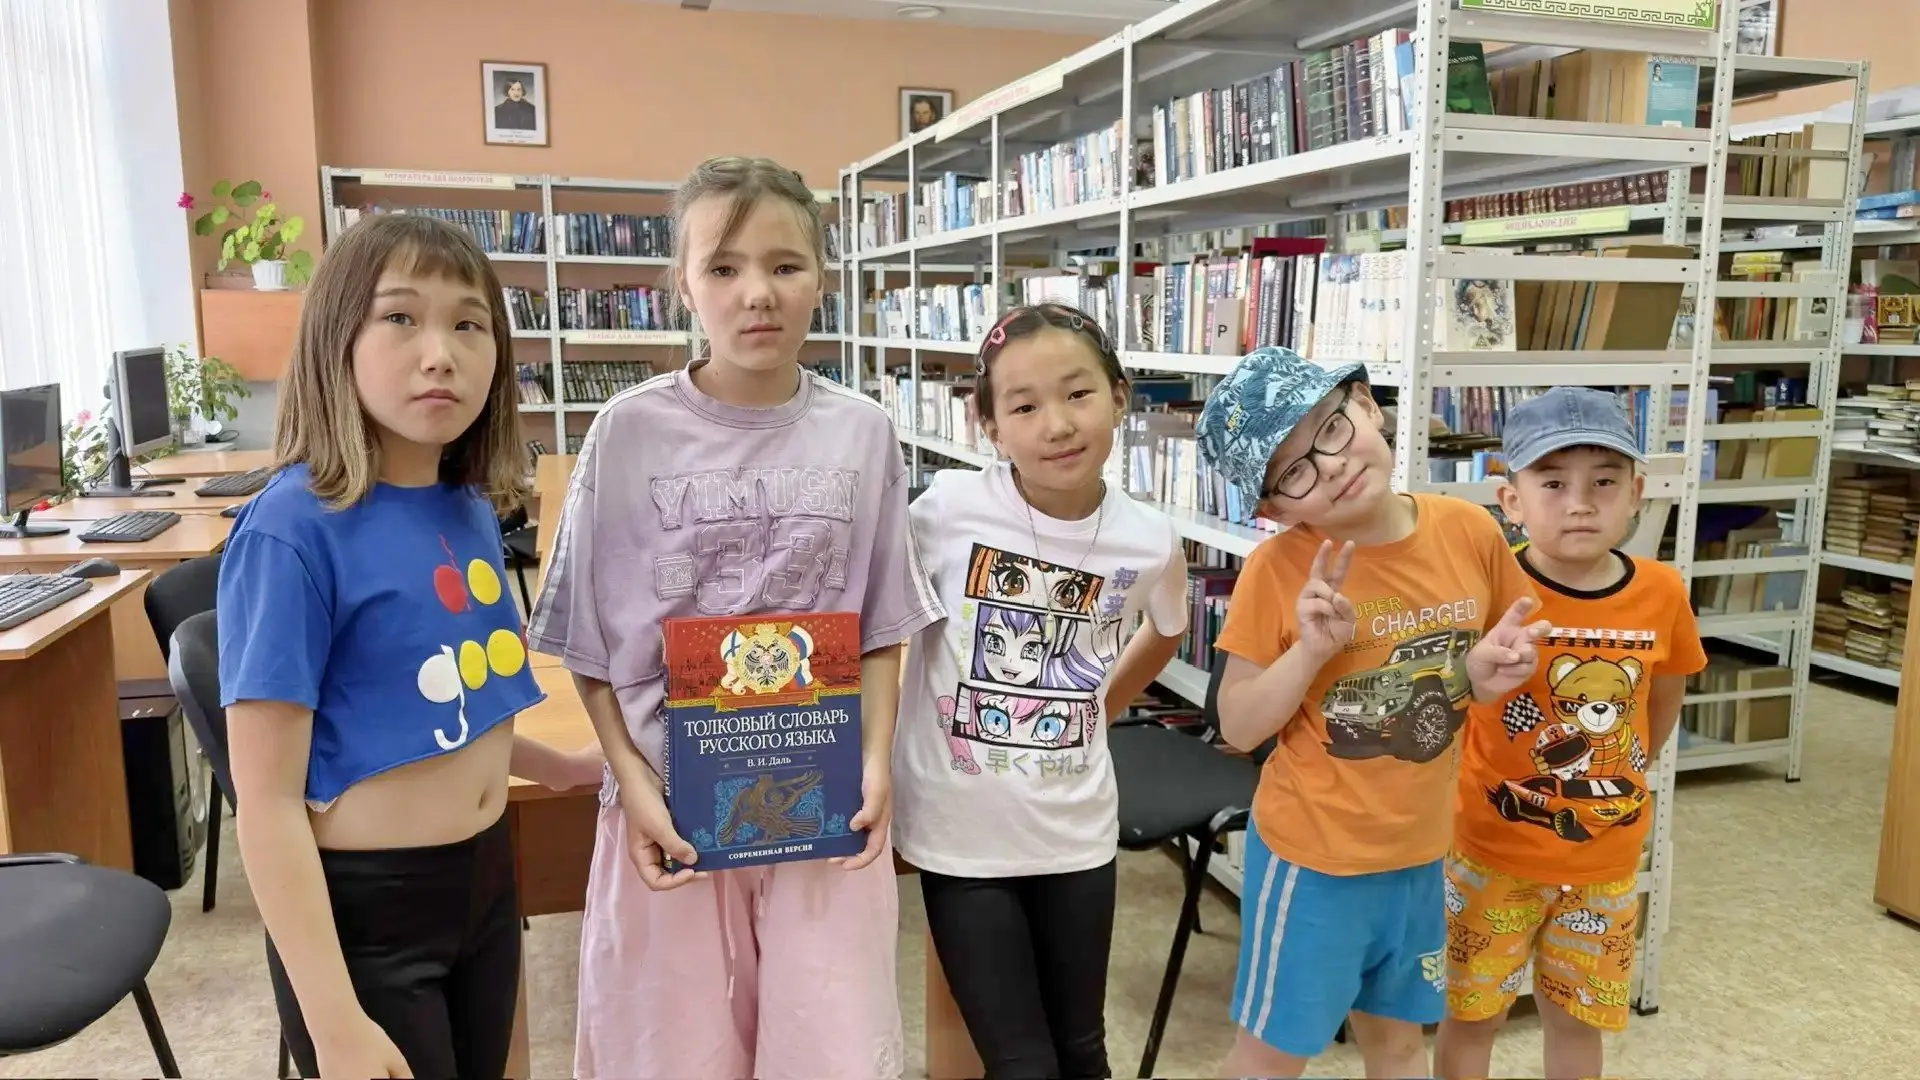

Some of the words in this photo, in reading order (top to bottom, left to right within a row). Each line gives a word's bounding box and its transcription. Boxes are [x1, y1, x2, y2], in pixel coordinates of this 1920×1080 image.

[1355, 596, 1403, 619] UPER
[1371, 599, 1478, 637] CHARGED
[684, 712, 777, 737] ТОЛКОВЫЙ
[779, 709, 849, 729] СЛОВАРЬ
[699, 733, 782, 755] РУССКОГО
[784, 729, 837, 748] ЯЗЫКА
[747, 758, 756, 767] В.
[758, 757, 768, 766] И.
[769, 756, 792, 767] Даль
[728, 847, 783, 860] СОВРЕМЕННАЯ
[785, 843, 813, 854] ВЕРСИЯ
